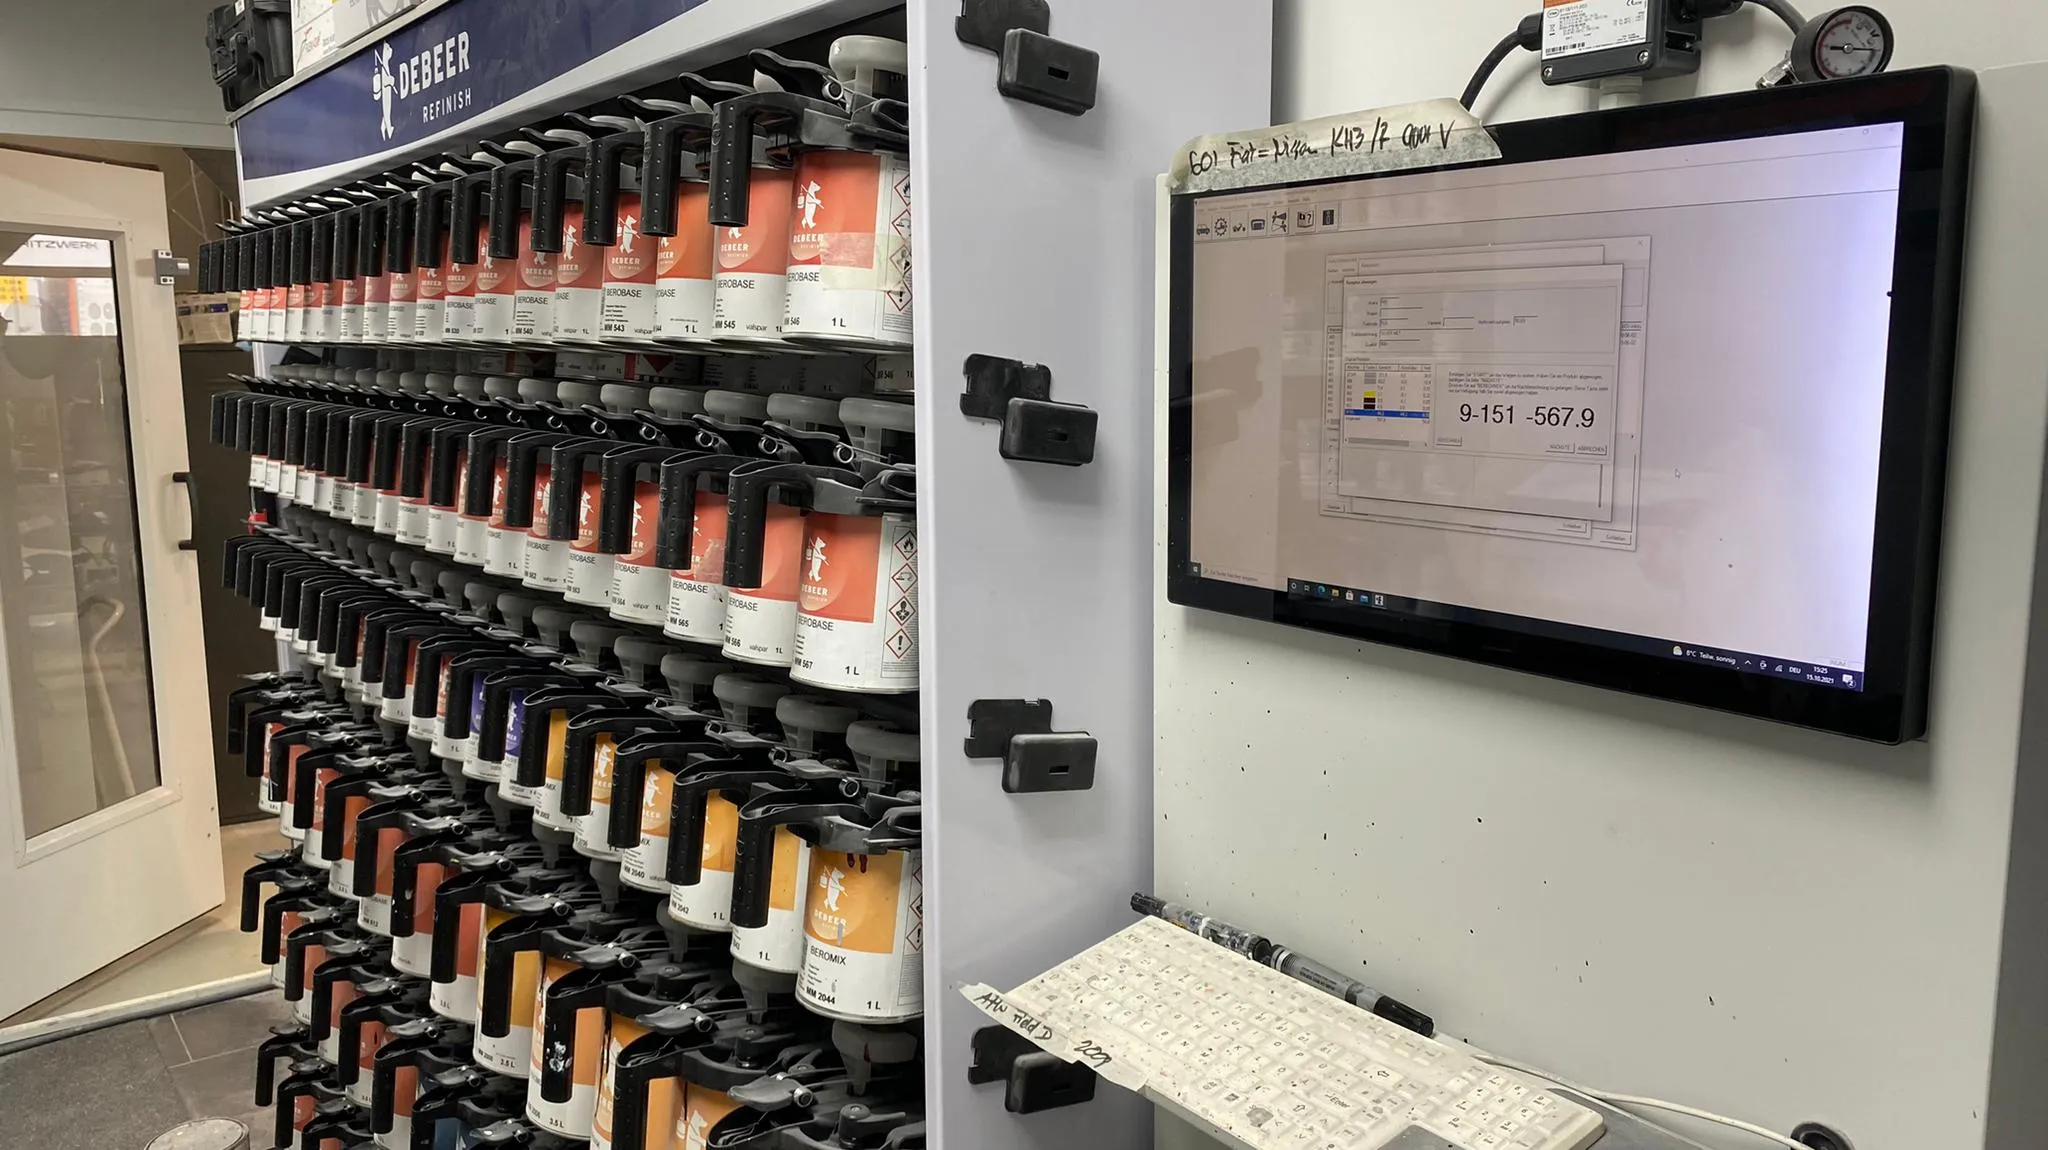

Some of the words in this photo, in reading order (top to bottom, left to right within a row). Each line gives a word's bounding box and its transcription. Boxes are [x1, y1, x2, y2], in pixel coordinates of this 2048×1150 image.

[400, 31, 470, 99] DEBEER
[423, 88, 471, 123] REFINISH
[25, 240, 98, 250] ITZWERK
[787, 272, 820, 282] EROBASE
[724, 320, 736, 329] 545
[790, 317, 800, 325] 546
[613, 324, 625, 332] 543
[1460, 403, 1513, 424] 9-151
[1526, 405, 1595, 428] -567.9
[728, 597, 758, 612] EROBASE
[678, 618, 689, 628] 565
[731, 636, 741, 648] 566
[802, 658, 813, 670] 567
[1716, 654, 1736, 665] sonnig
[810, 945, 847, 966] BEROMIX
[805, 985, 816, 999] MM
[818, 991, 836, 1005] 2044
